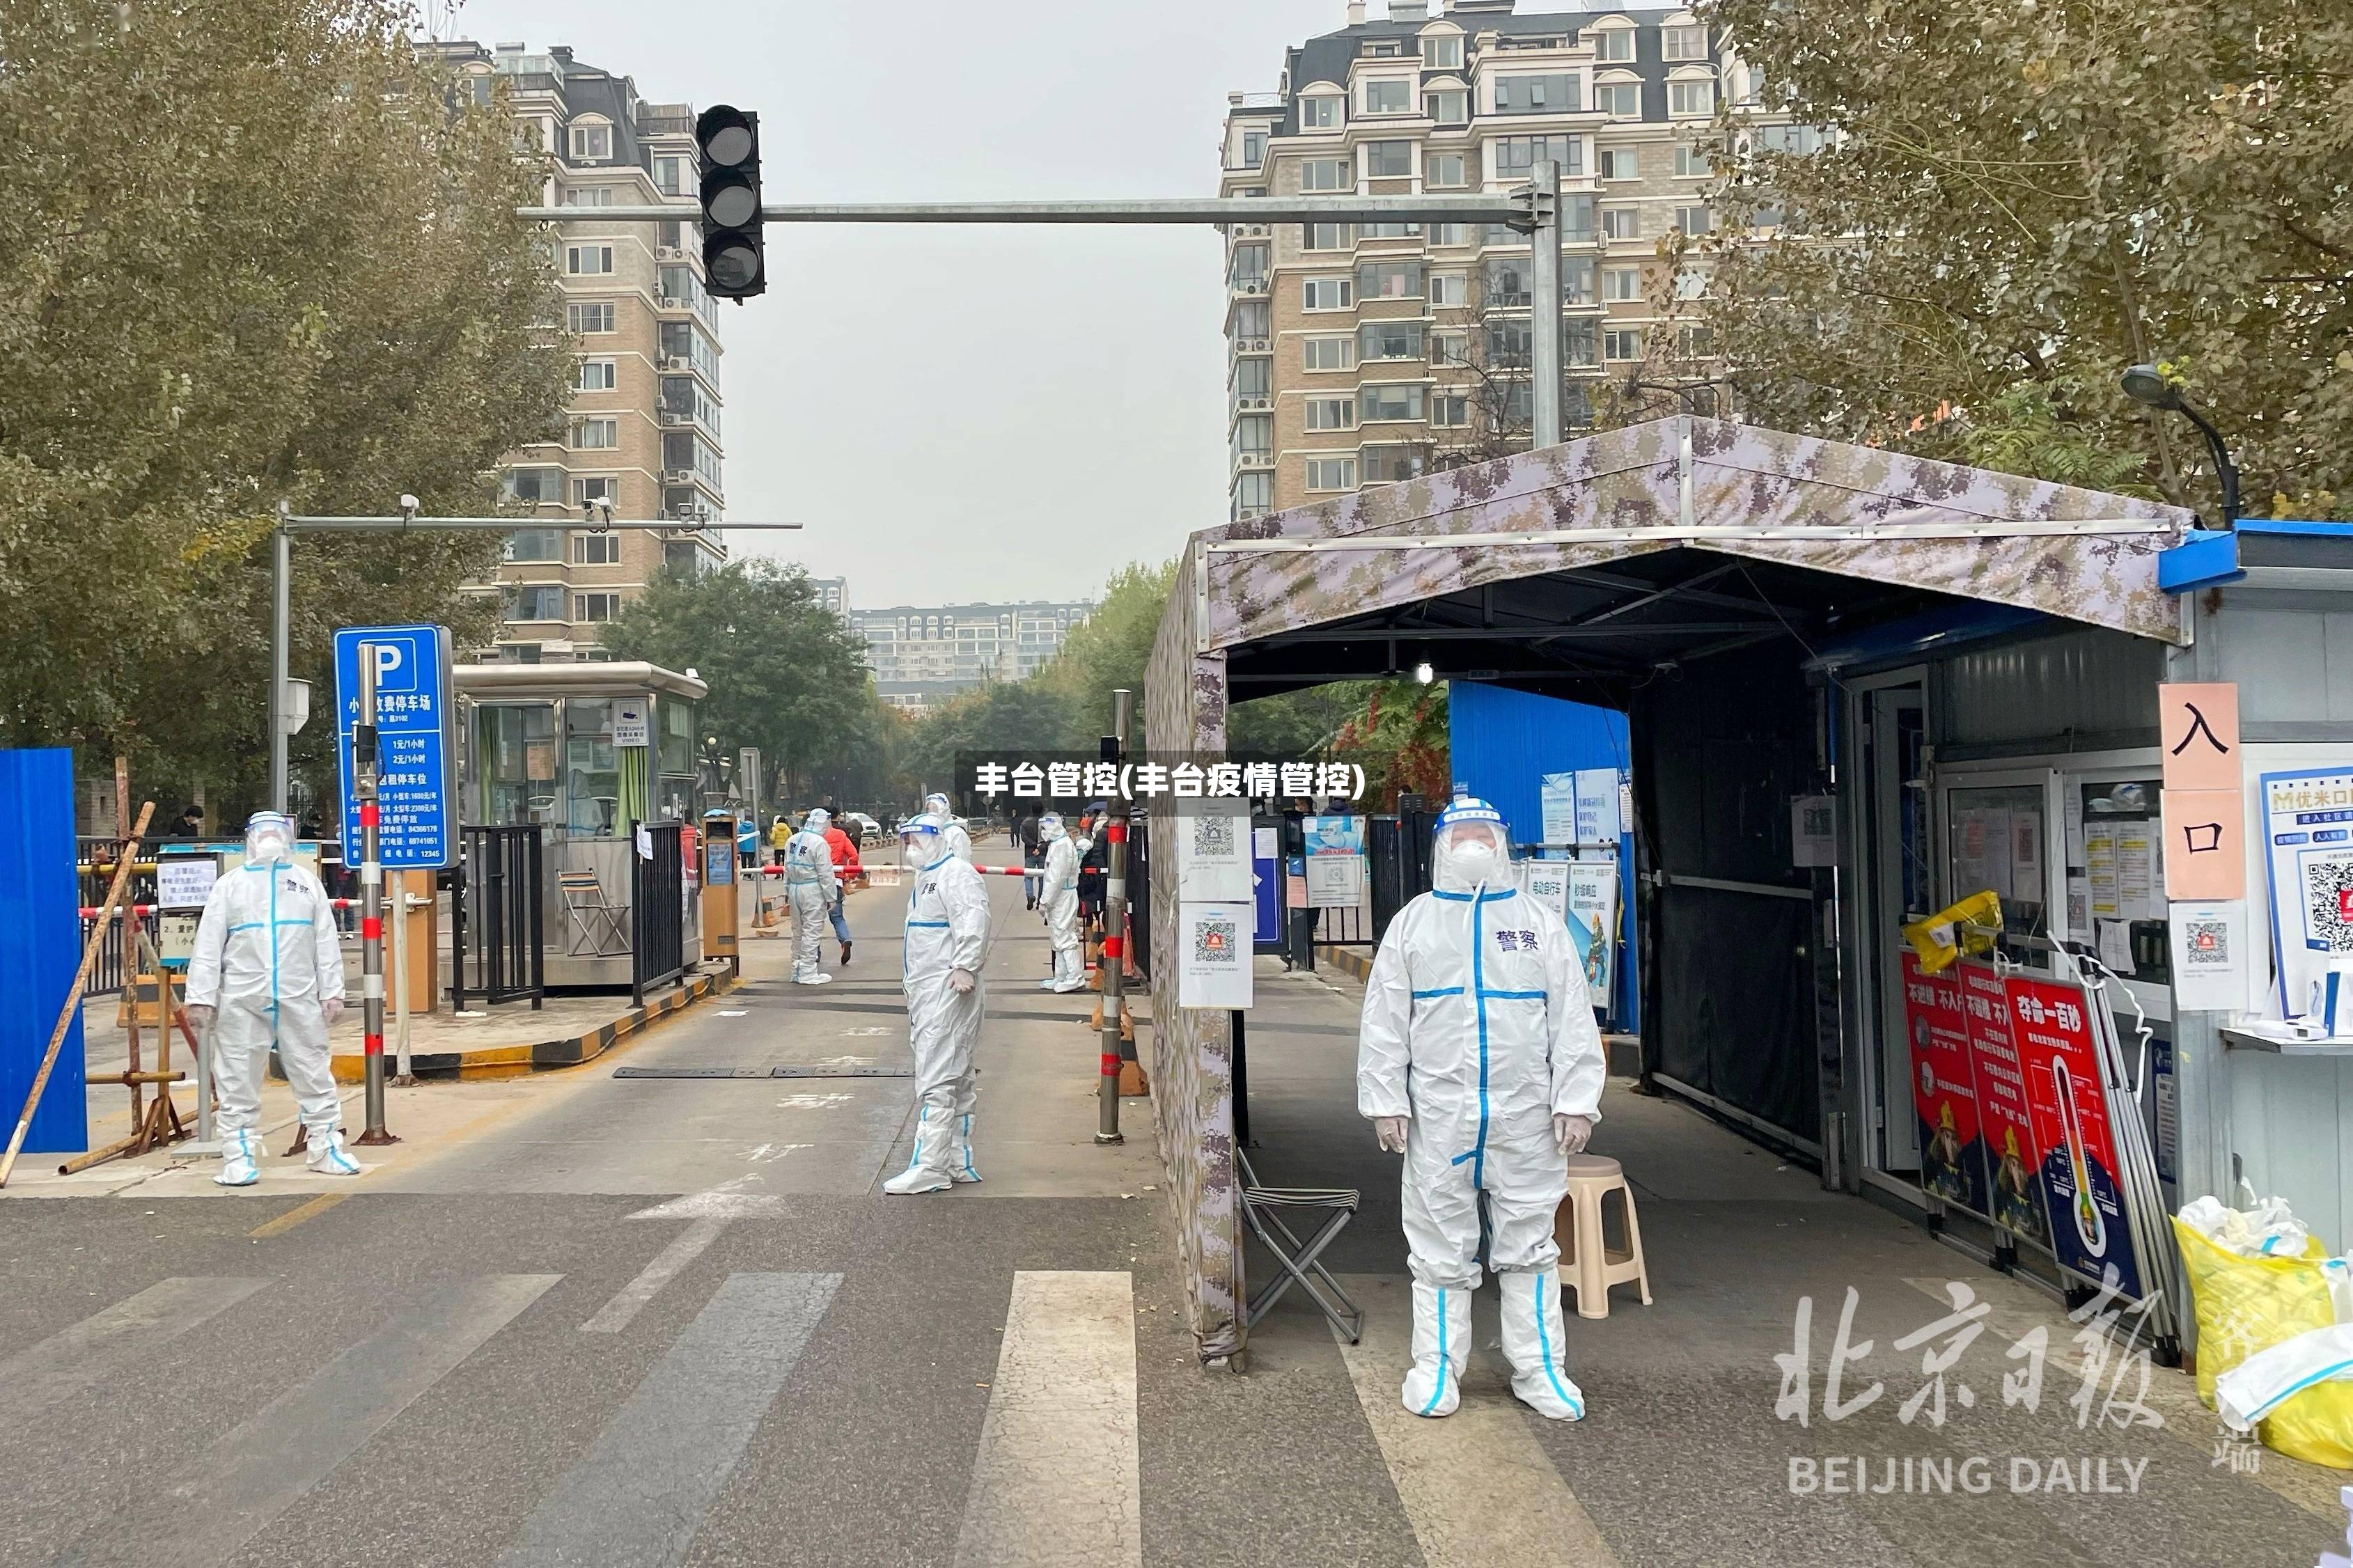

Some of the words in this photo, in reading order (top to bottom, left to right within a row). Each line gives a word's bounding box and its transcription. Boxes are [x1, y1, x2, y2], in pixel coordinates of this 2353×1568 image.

[376, 645, 402, 687] P
[349, 694, 431, 713] 小收费停车场
[393, 739, 425, 749] 1元/1小时
[393, 754, 425, 765] 2元/1小时
[2172, 703, 2229, 855] 入口
[2296, 788, 2353, 808] 优米口
[286, 879, 309, 894] 警察
[1533, 880, 1561, 895] 电动自行车
[1496, 930, 1538, 952] 警察
[2017, 995, 2081, 1033] 夺命一百秒
